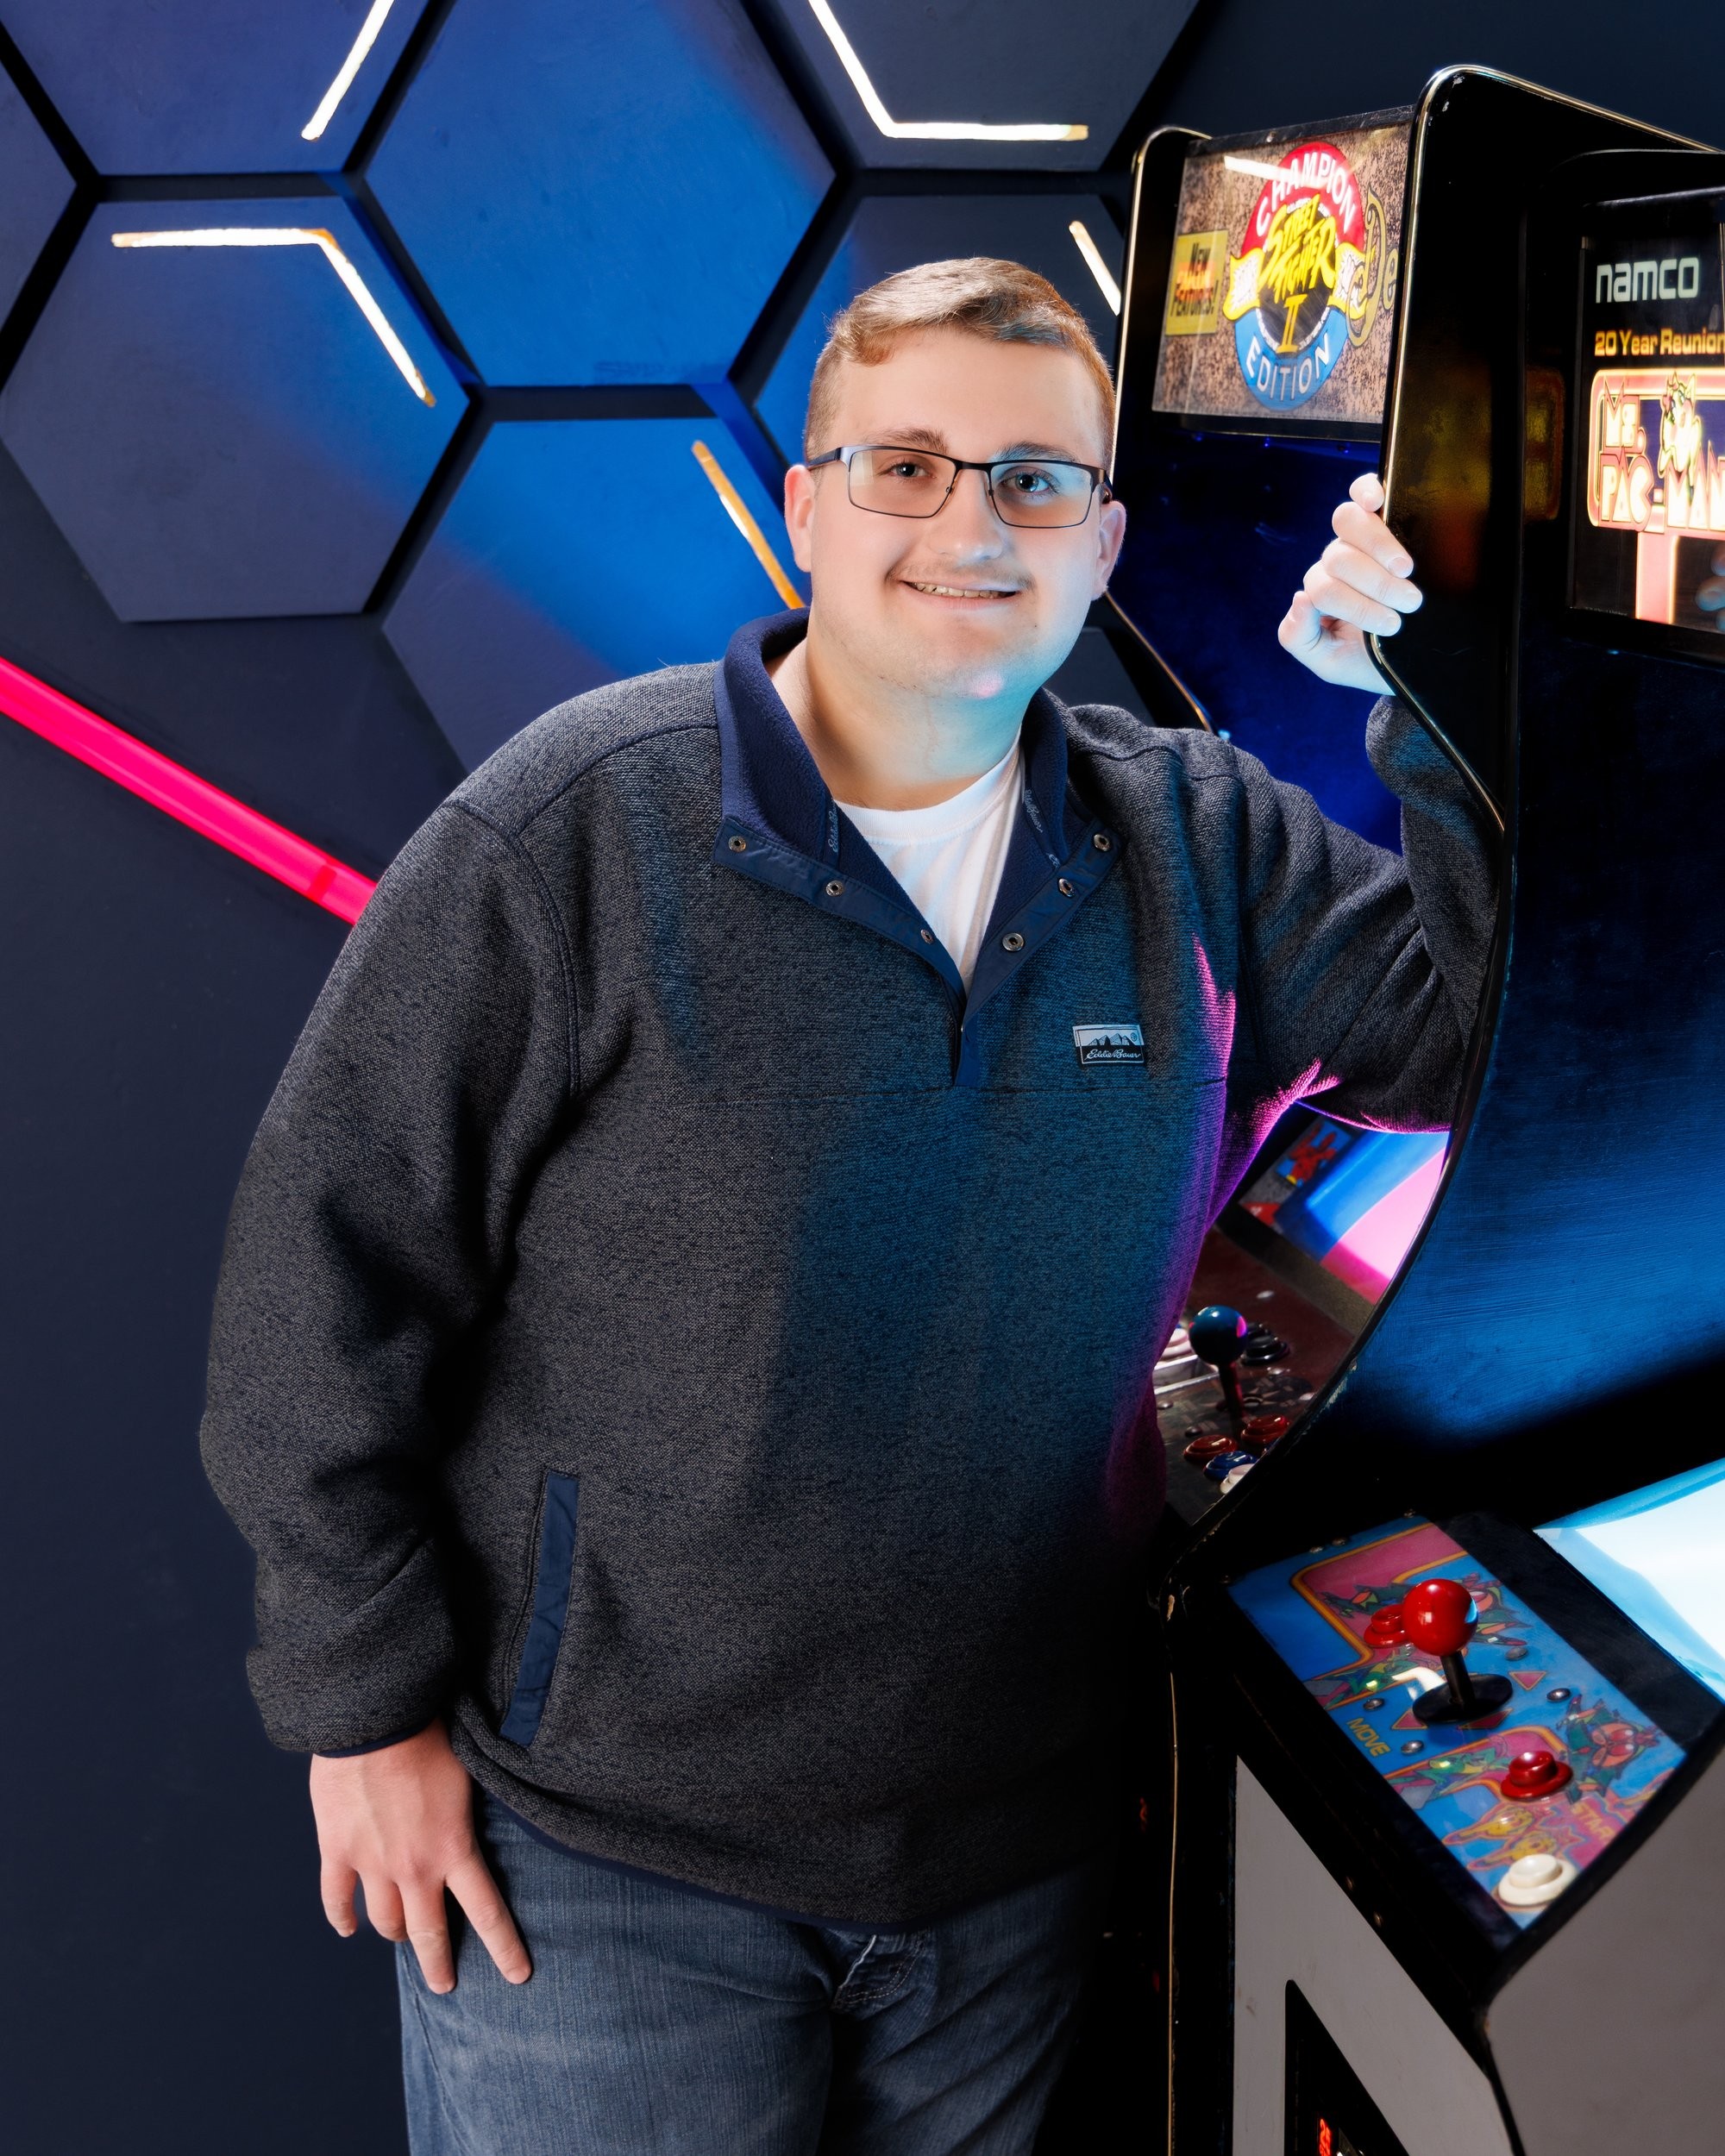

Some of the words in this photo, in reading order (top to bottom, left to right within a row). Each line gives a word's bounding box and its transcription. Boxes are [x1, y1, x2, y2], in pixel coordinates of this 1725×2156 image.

[1257, 152, 1356, 236] CHAMPION
[1596, 257, 1699, 303] namco
[1595, 330, 1617, 356] 20
[1619, 329, 1658, 356] Year
[1660, 327, 1725, 355] Reunion
[1246, 332, 1329, 401] EDITION
[1084, 1049, 1113, 1060] Eddie
[1113, 1049, 1141, 1058] Bauer
[1346, 1717, 1391, 1757] MOVE
